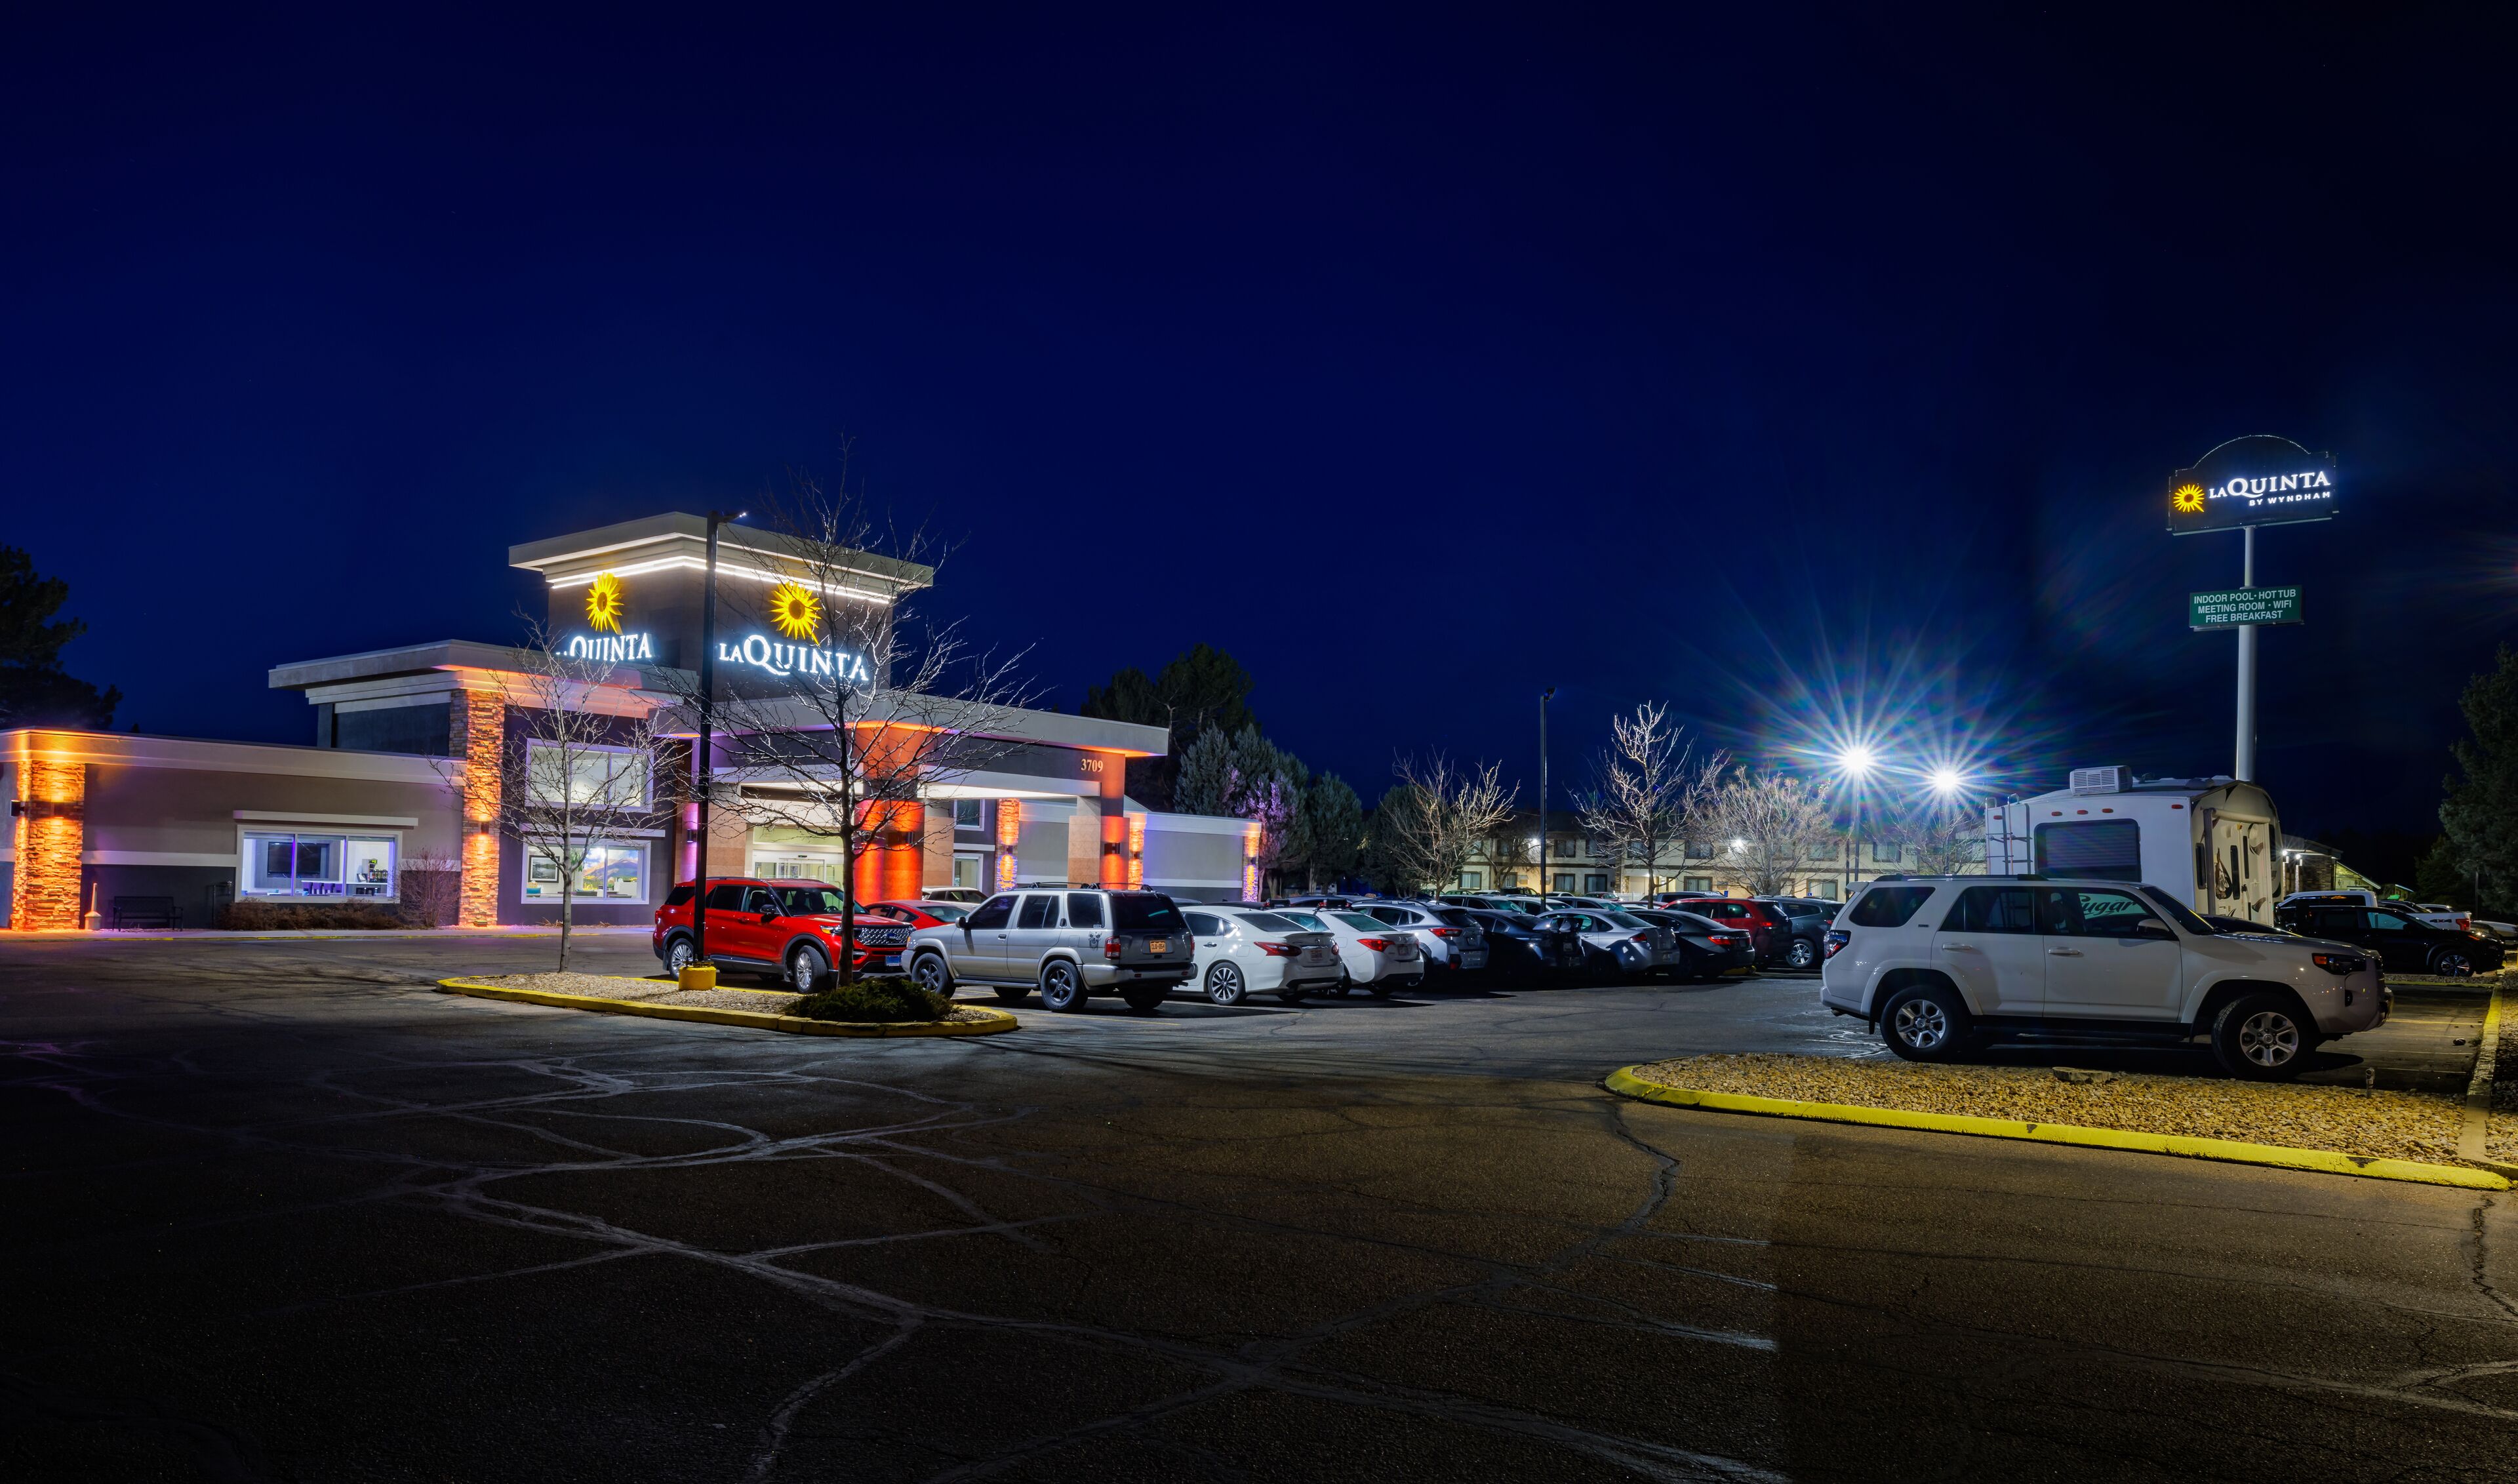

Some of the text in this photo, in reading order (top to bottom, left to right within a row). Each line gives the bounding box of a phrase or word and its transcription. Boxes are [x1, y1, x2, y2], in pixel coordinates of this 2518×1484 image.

[2209, 471, 2331, 498] LA QUINTA
[2249, 491, 2330, 507] BY WYNDHAM
[2194, 589, 2296, 604] INDOOR POOL HOT TUB
[2198, 599, 2292, 614] MEETING ROOM WIFI
[2205, 610, 2283, 623] FREE BREAKFAST
[719, 634, 869, 681] LA QUINTA
[1081, 759, 1104, 772] 3709
